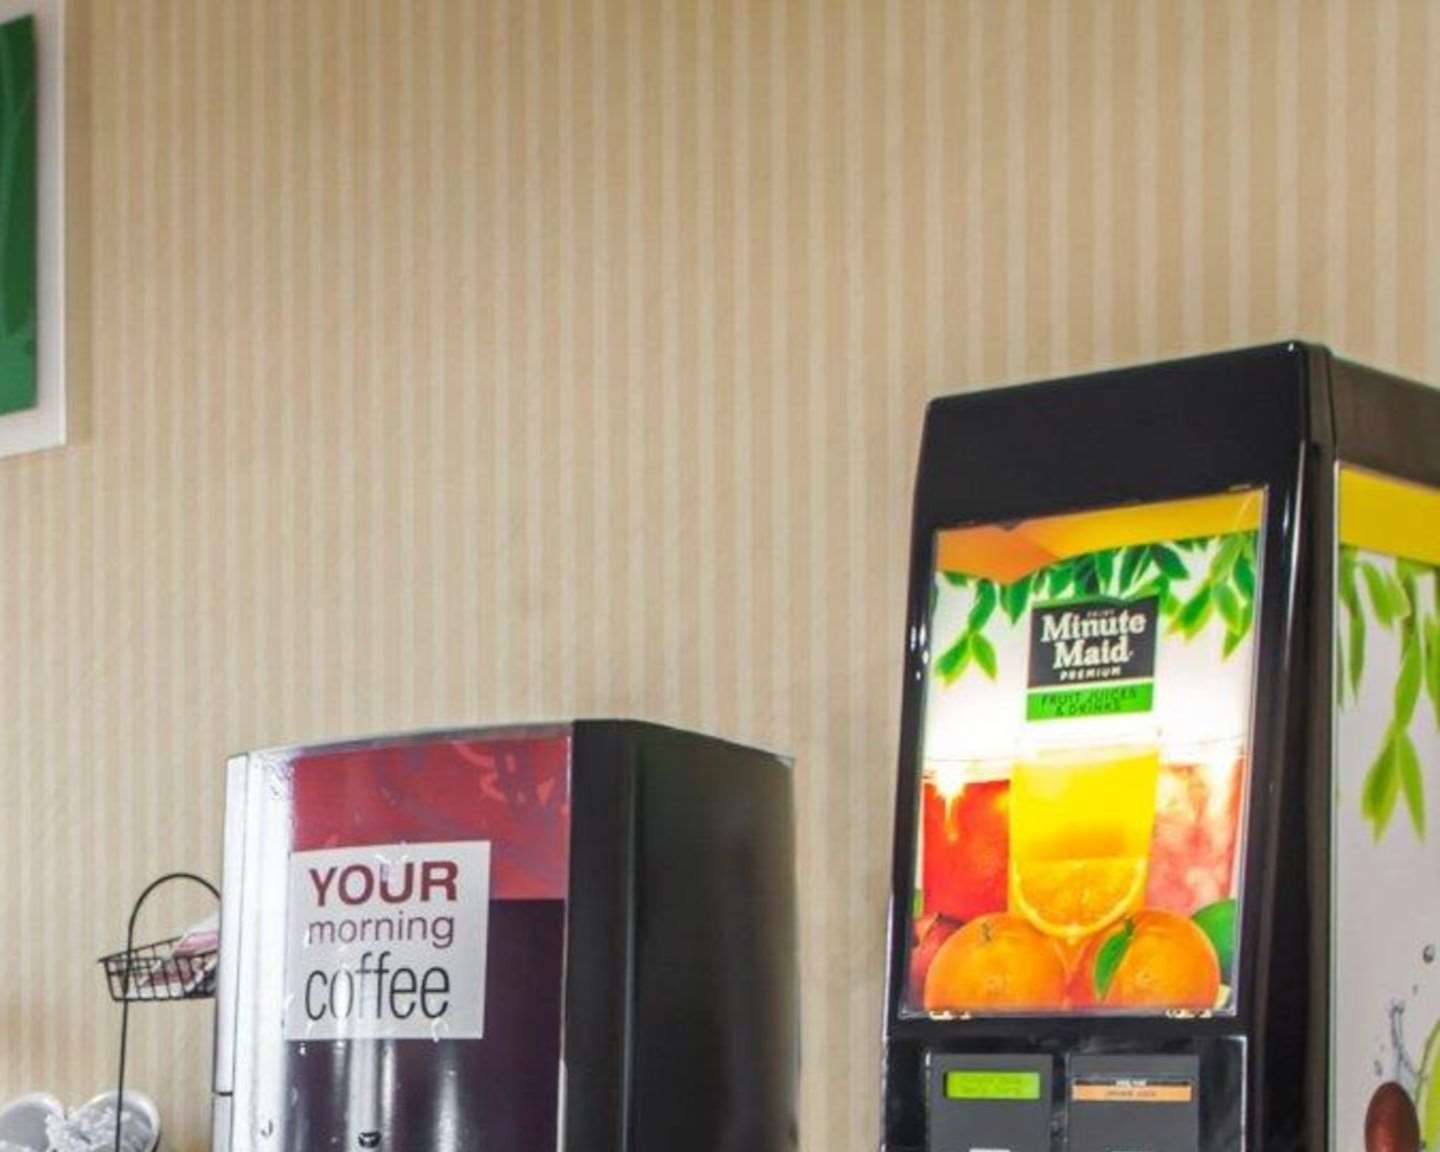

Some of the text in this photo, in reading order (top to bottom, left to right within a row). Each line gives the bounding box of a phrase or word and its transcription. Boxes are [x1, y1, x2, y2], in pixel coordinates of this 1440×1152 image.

[1040, 609, 1147, 642] Minute
[1052, 635, 1132, 669] Maid
[1060, 666, 1121, 681] PREMIUM
[308, 860, 458, 906] YOUR
[307, 911, 456, 949] morning
[304, 951, 450, 1021] coffee
